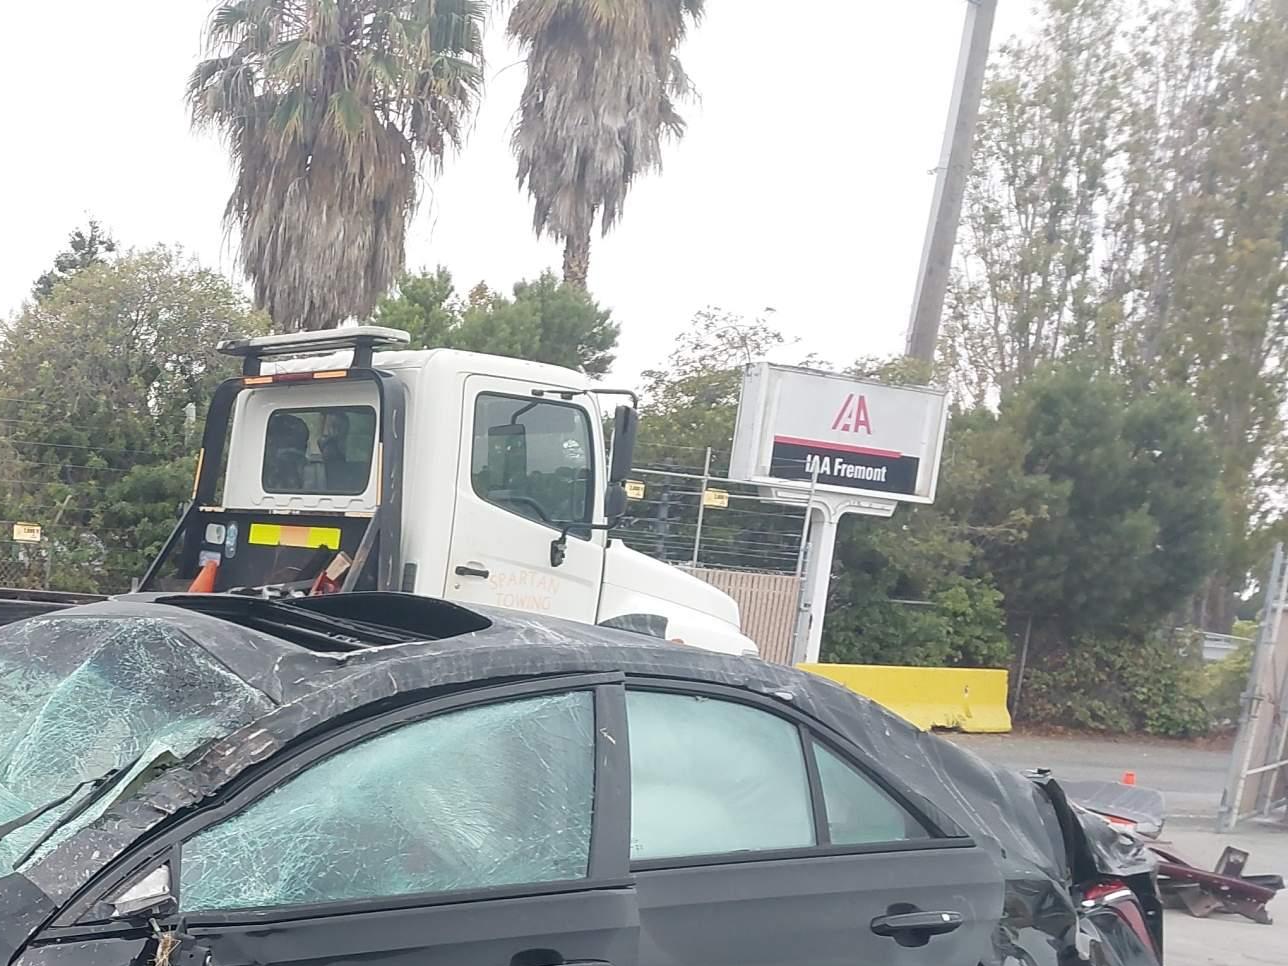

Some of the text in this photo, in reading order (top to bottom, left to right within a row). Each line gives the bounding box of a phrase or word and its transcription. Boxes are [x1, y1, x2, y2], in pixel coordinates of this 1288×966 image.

[805, 453, 887, 482] IAA Fremont
[489, 570, 560, 594] SPARTAN
[496, 592, 551, 610] TOWING
